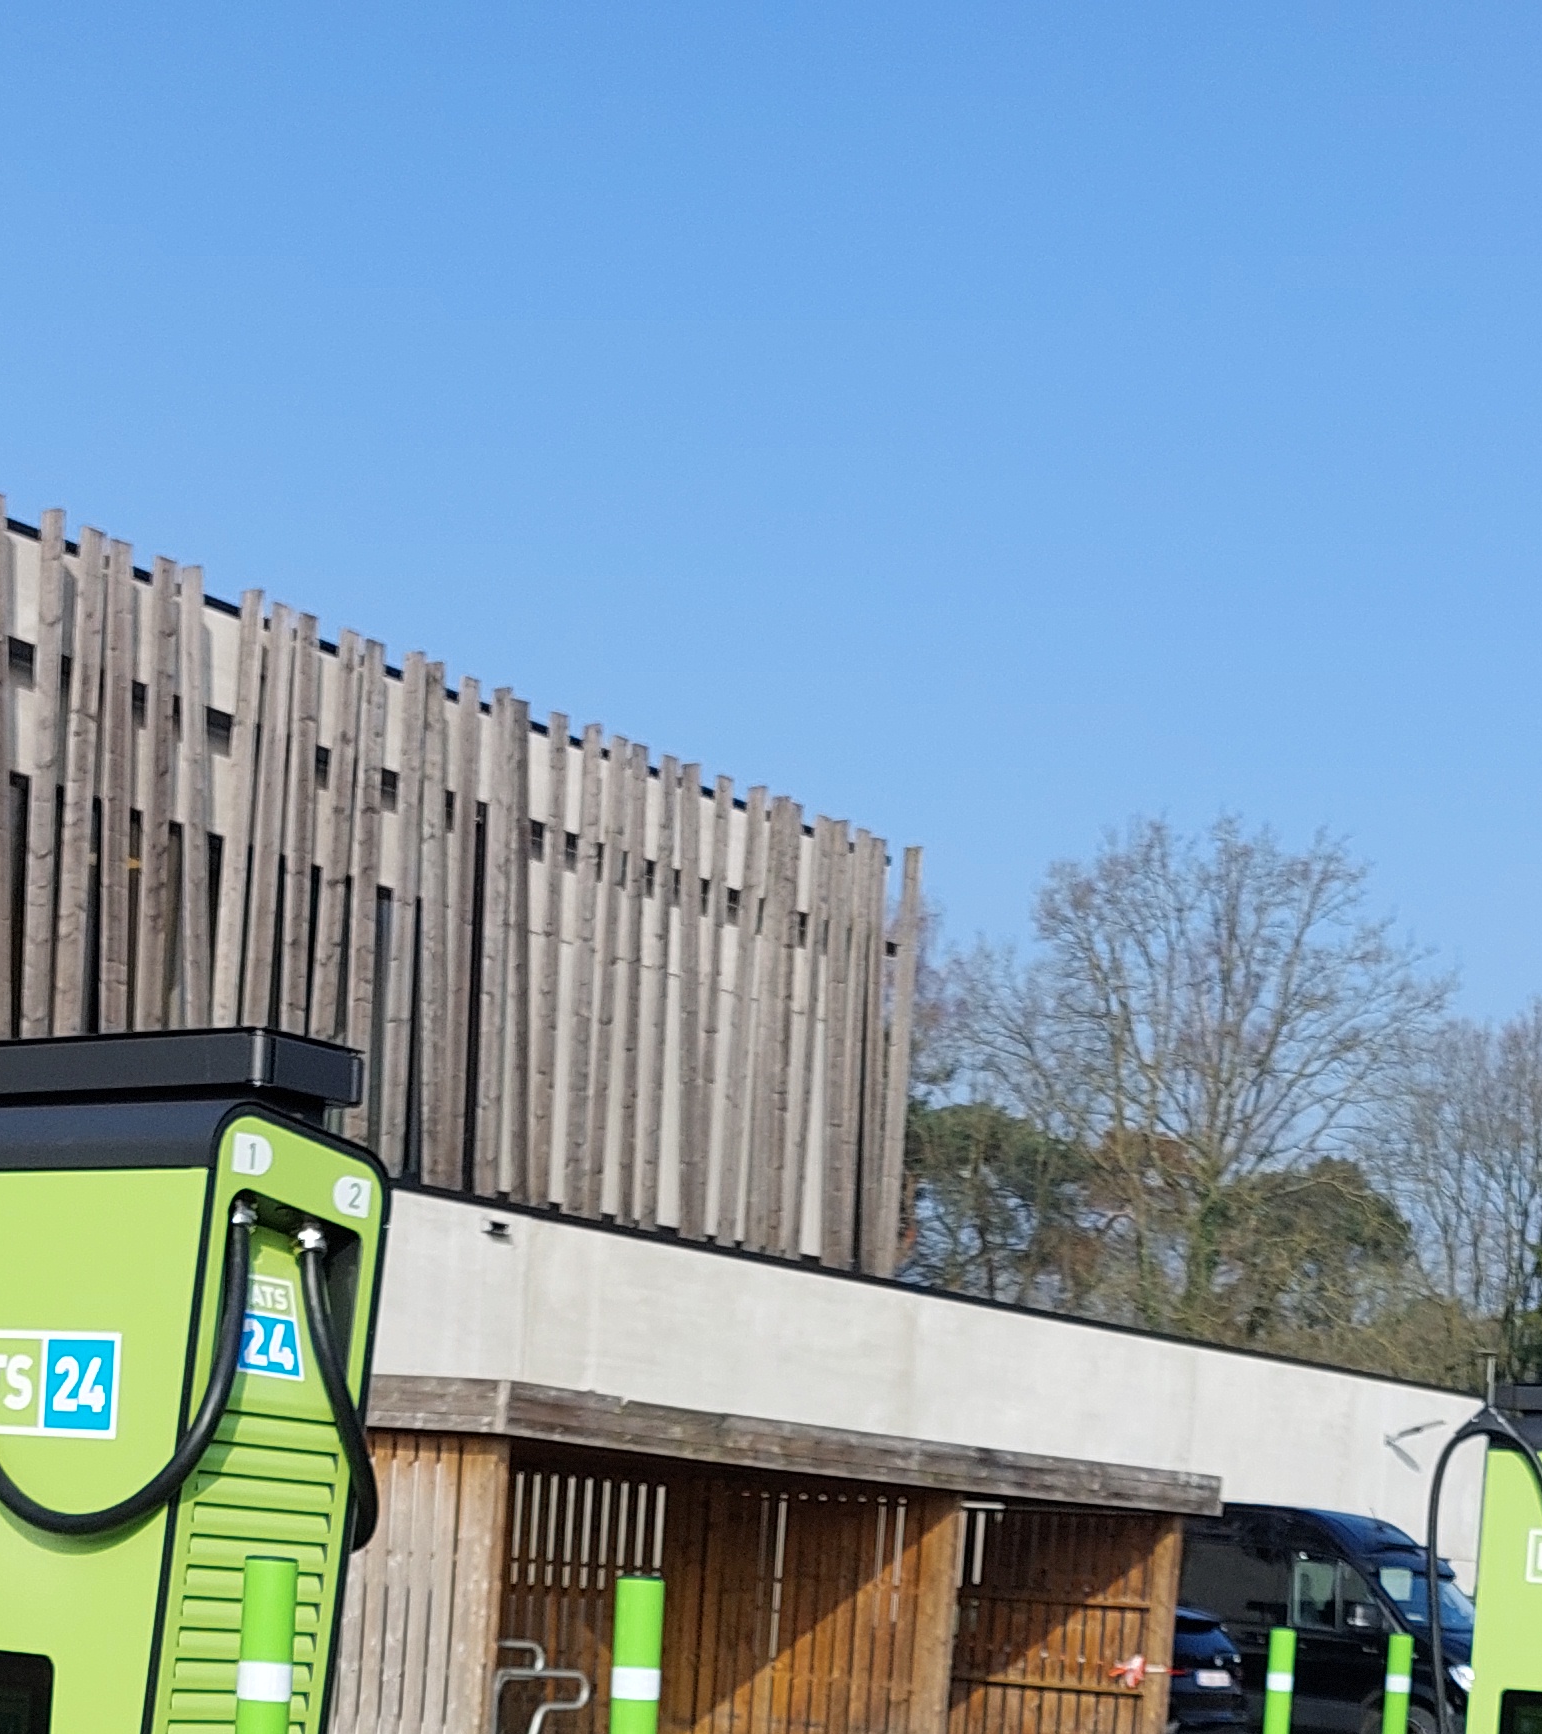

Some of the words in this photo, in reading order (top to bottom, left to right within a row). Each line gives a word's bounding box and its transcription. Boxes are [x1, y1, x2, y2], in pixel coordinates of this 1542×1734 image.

[249, 1142, 257, 1170] 1
[348, 1182, 362, 1209] 2
[252, 1282, 288, 1310] ATS
[242, 1318, 295, 1371] 24
[52, 1355, 106, 1413] 24
